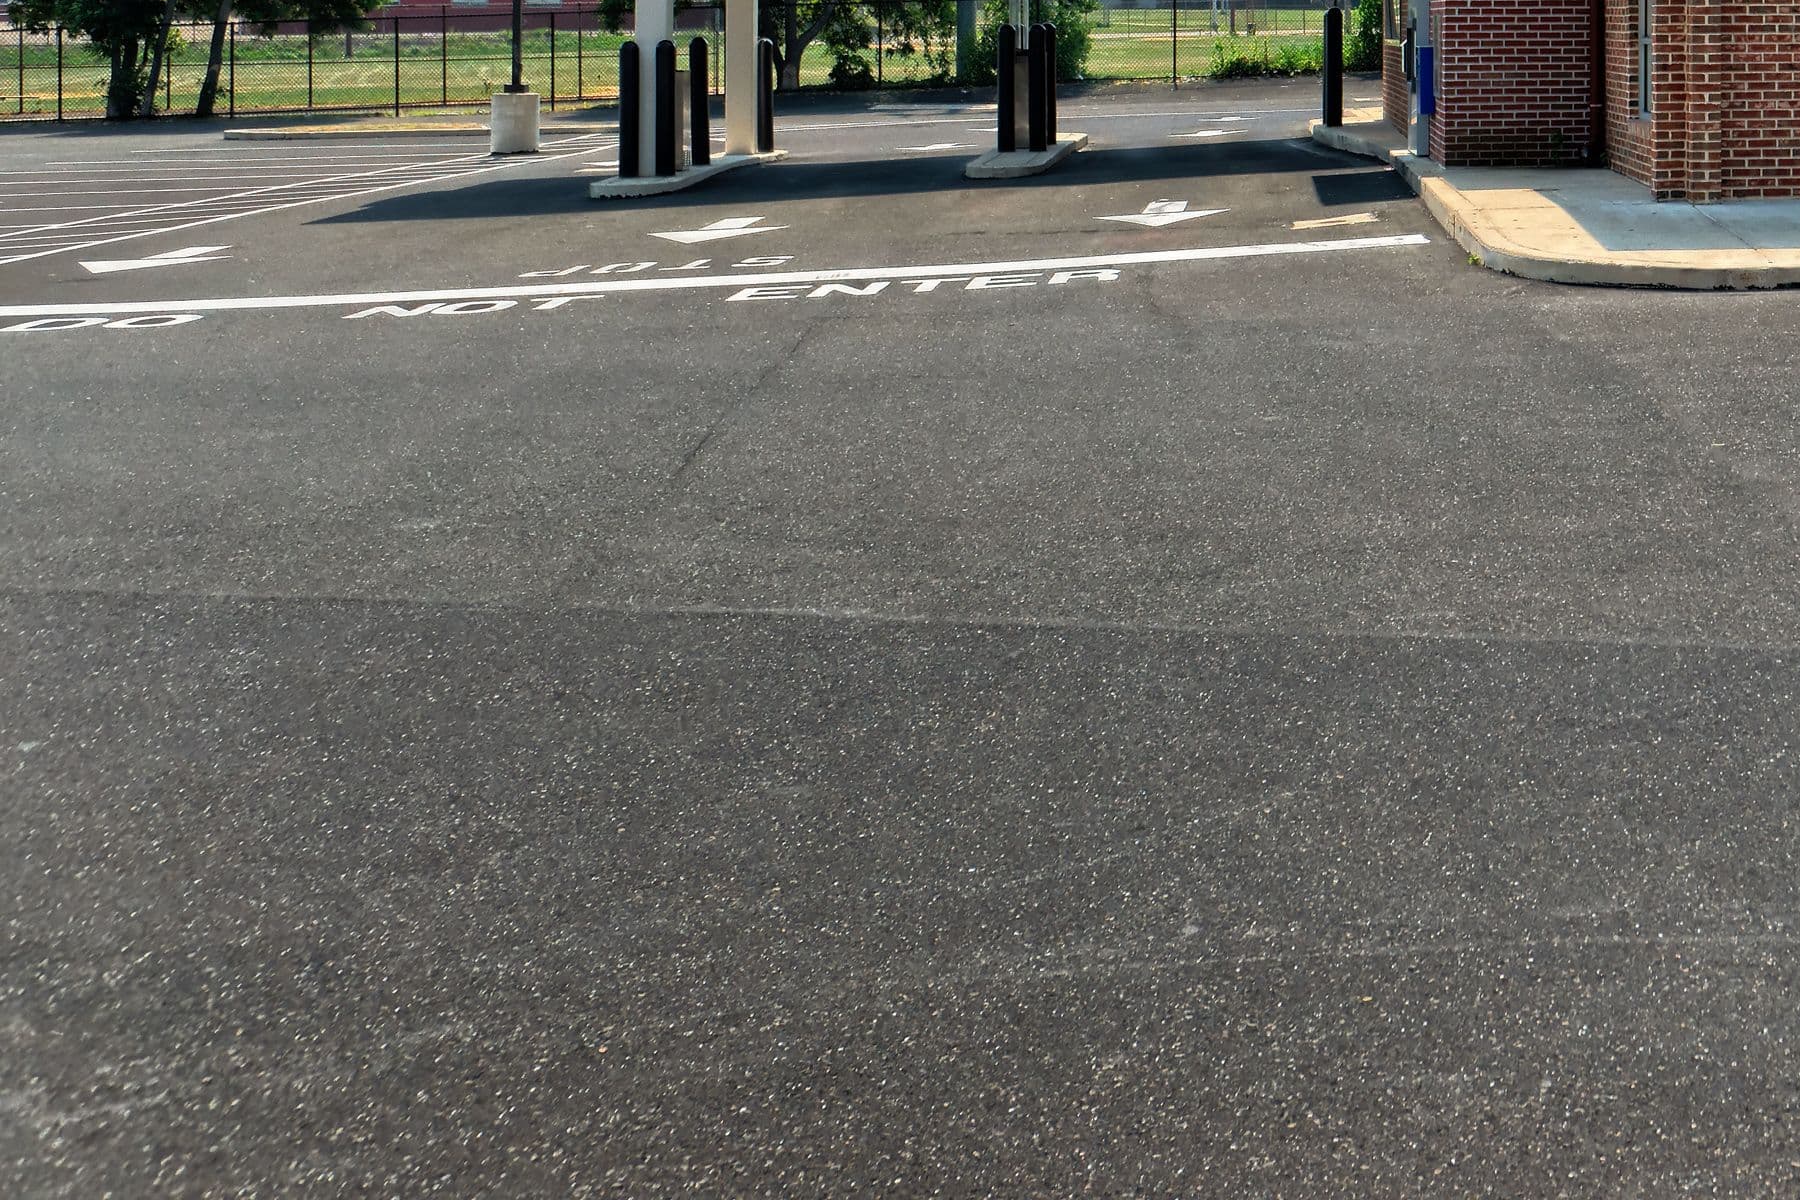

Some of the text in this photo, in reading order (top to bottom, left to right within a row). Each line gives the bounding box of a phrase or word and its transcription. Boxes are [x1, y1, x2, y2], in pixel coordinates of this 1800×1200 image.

[518, 255, 794, 277] STOP
[0, 268, 1121, 332] DO NOT ENTER
